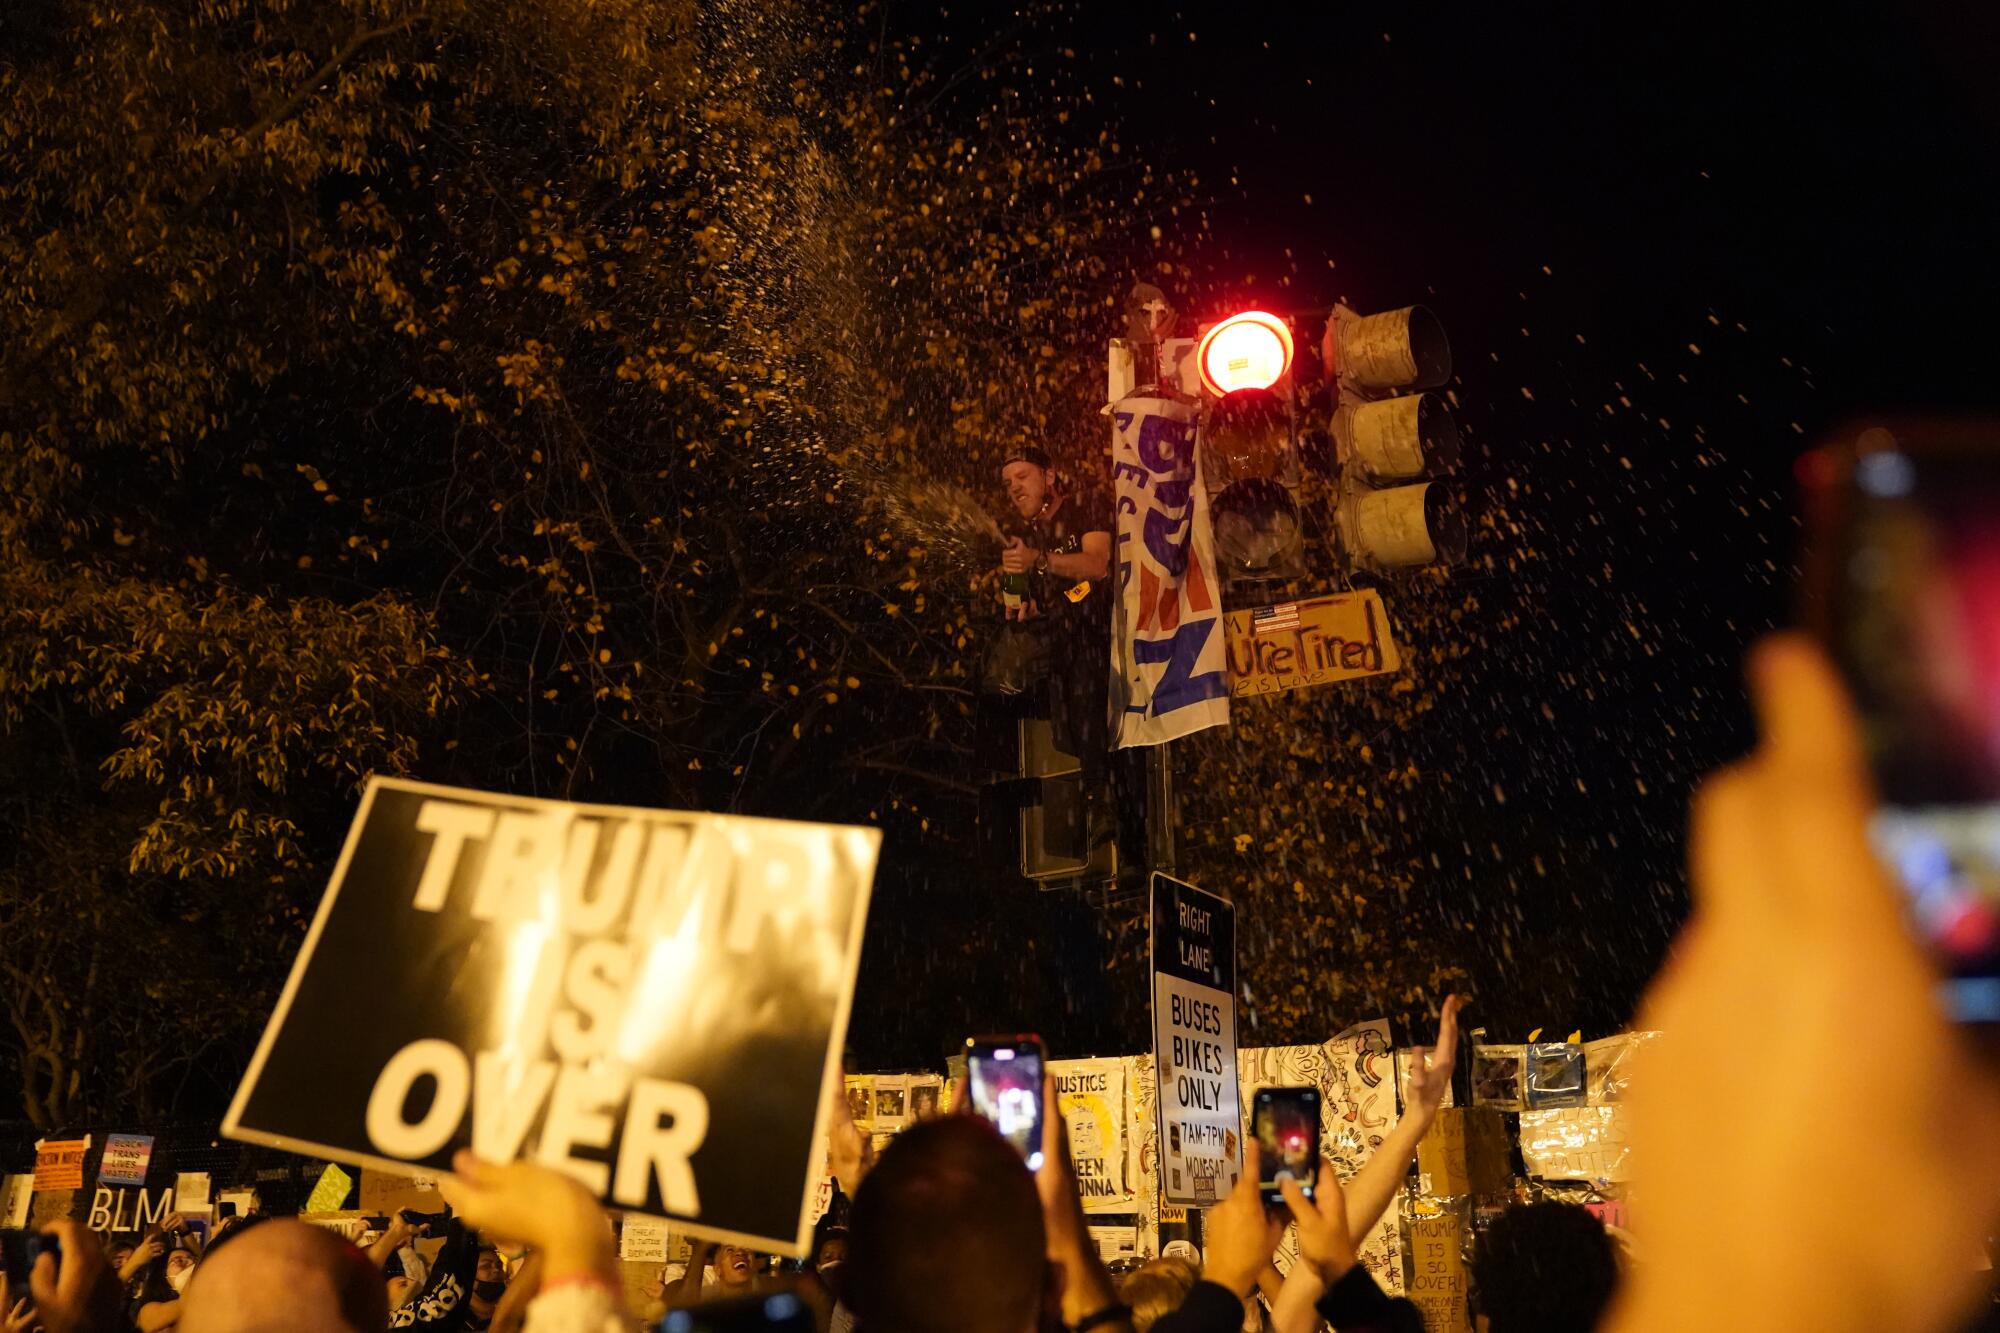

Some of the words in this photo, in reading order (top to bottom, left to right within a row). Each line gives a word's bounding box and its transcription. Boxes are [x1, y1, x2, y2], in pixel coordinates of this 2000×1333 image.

[412, 800, 815, 954] TRUMP
[1179, 902, 1212, 936] RIGHT
[1181, 940, 1210, 973] LANE
[1171, 993, 1221, 1036] BUSES
[1173, 1035, 1222, 1076] BIKES
[1178, 1074, 1222, 1112] ONLY
[366, 1038, 710, 1218] OVER
[1180, 1122, 1225, 1147] 7AM-7PM
[111, 1159, 137, 1168] LIVES
[112, 1150, 141, 1159] TRANS
[105, 1169, 139, 1179] MATTER
[1185, 1156, 1225, 1180] MON-SAT
[87, 1188, 173, 1232] BLM
[1161, 1209, 1185, 1219] NOW
[1412, 1221, 1457, 1238] TRUMP
[1426, 1243, 1445, 1258] IS
[1427, 1261, 1447, 1274] SO
